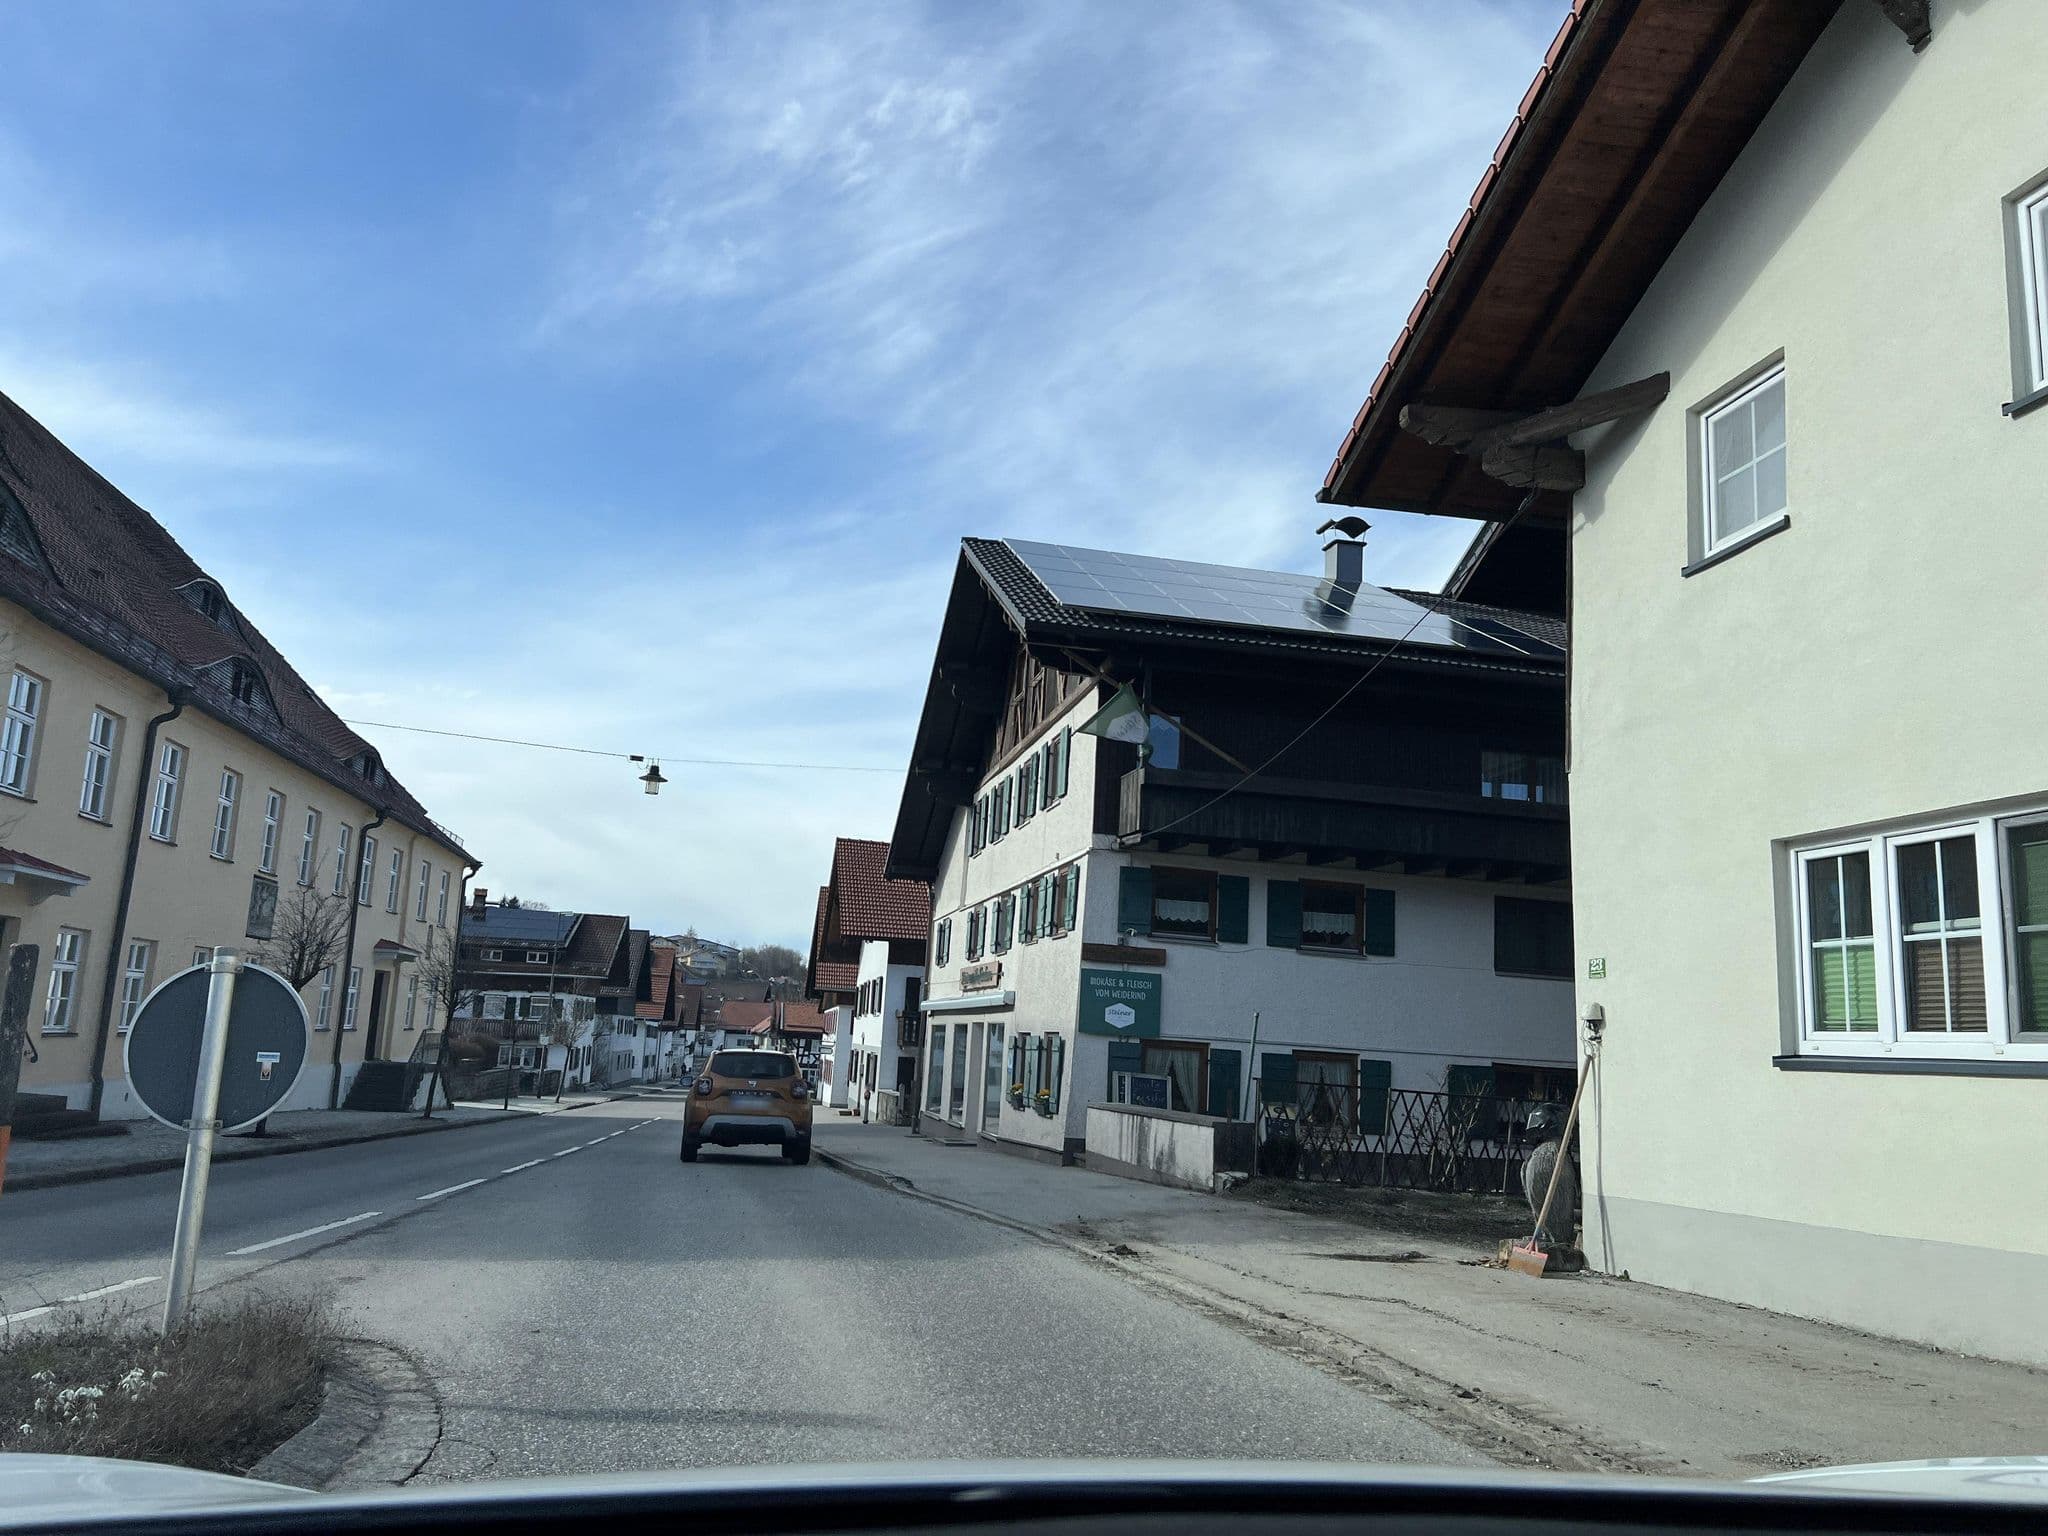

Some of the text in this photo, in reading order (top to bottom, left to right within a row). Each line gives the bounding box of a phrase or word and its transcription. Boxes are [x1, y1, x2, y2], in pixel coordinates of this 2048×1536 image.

[1590, 958, 1603, 971] 23
[1118, 979, 1124, 987] &
[1126, 979, 1152, 989] FLEISCH
[1095, 988, 1146, 1000] VOM WEIDERIND
